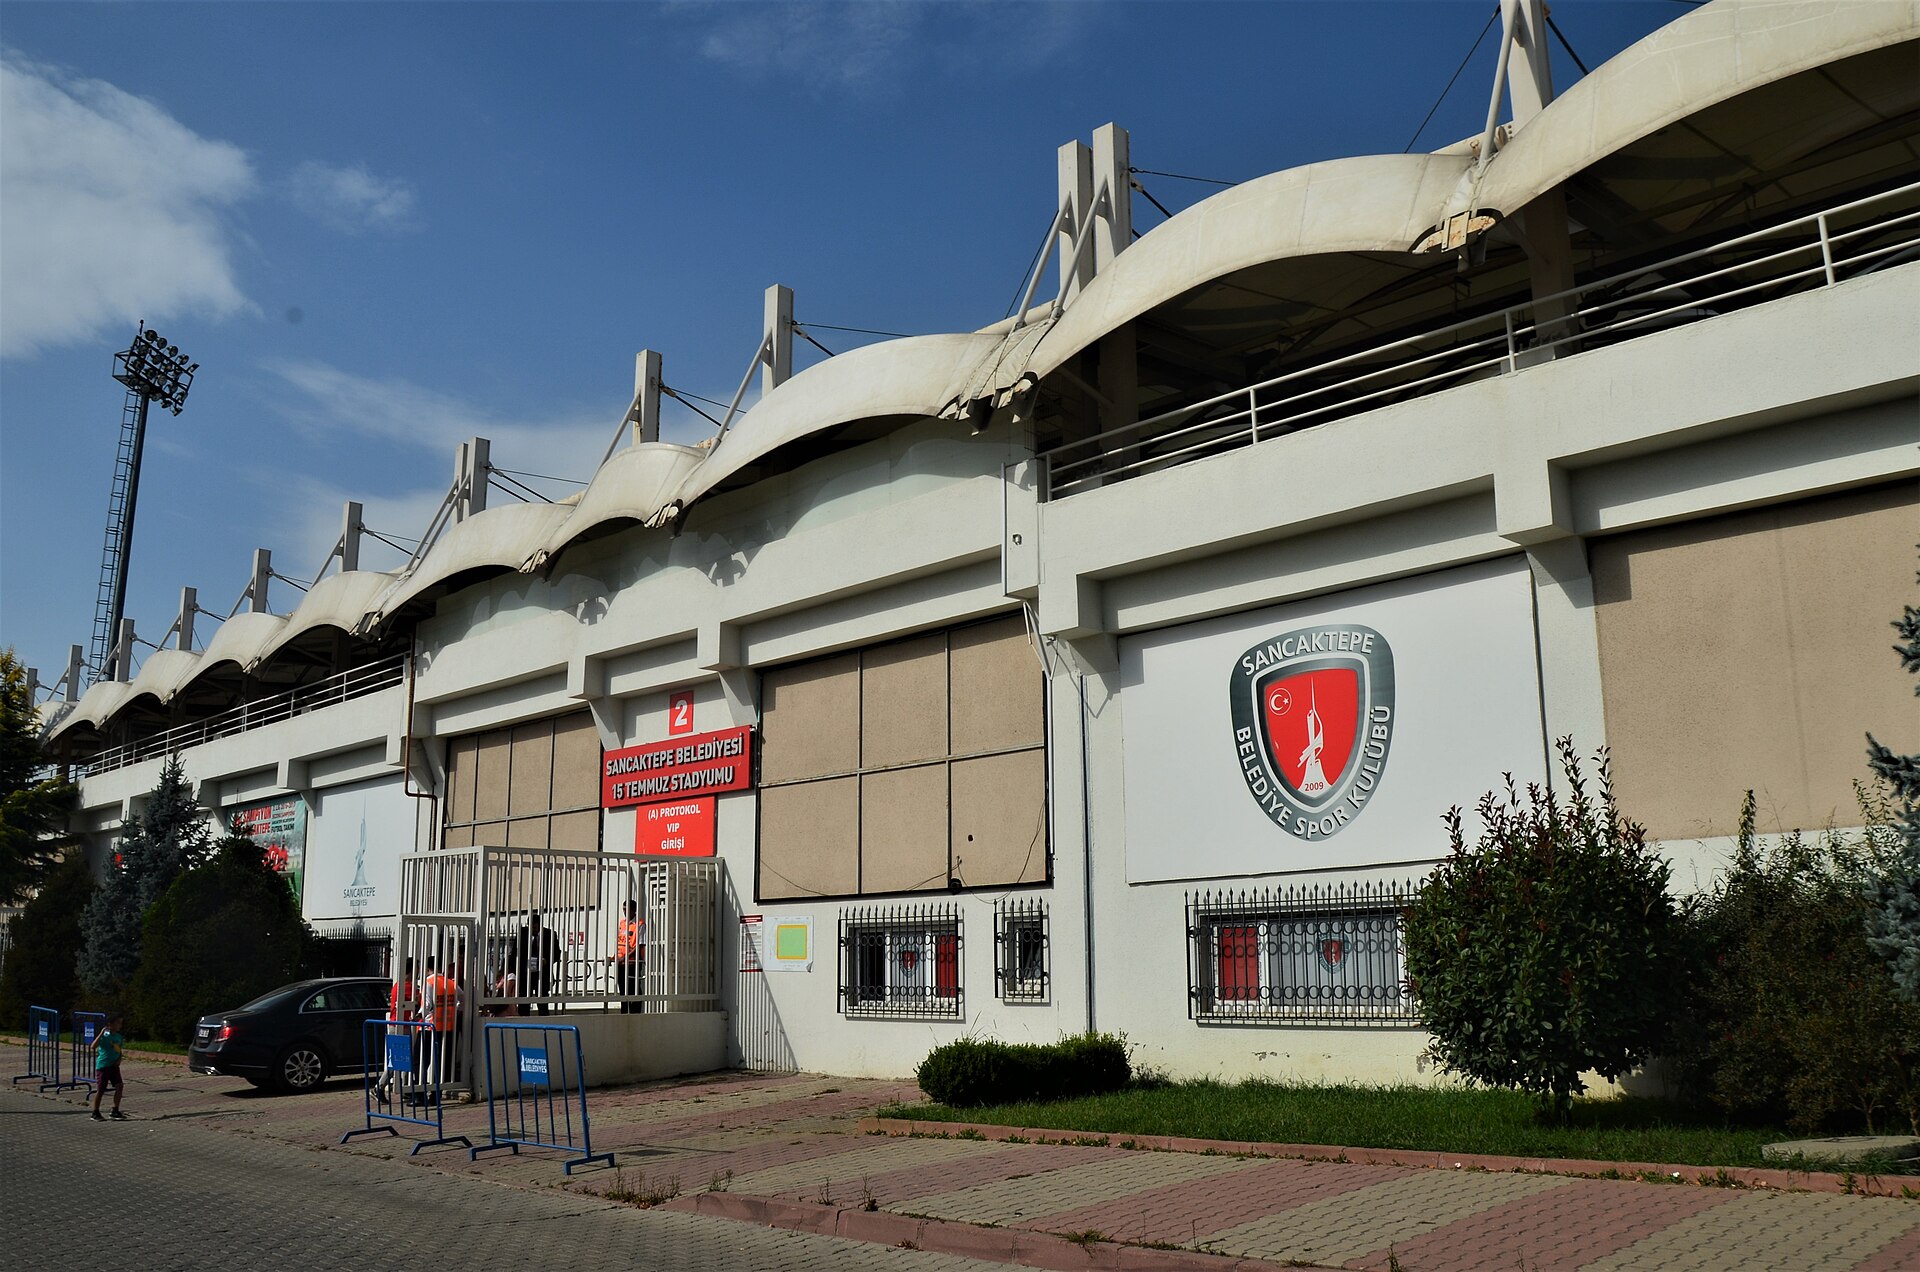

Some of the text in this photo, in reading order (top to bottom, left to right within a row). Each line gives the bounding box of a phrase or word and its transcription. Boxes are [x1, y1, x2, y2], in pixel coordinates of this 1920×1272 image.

[1242, 631, 1375, 676] SANCAKTEPE
[673, 699, 688, 727] 2
[606, 732, 743, 776] SANCAKTEPE BELEDİYESİ
[612, 766, 733, 799] 15 TEMMUZ STADYUMU
[1236, 706, 1391, 839] BELEDİYE SPOR KULÜBÜ
[1304, 781, 1324, 791] 2009
[648, 804, 701, 821] (A) PROTOKOL
[666, 823, 680, 833] VIP
[661, 836, 685, 851] GİRİŞİ
[343, 887, 376, 898] SANCAKTEPE
